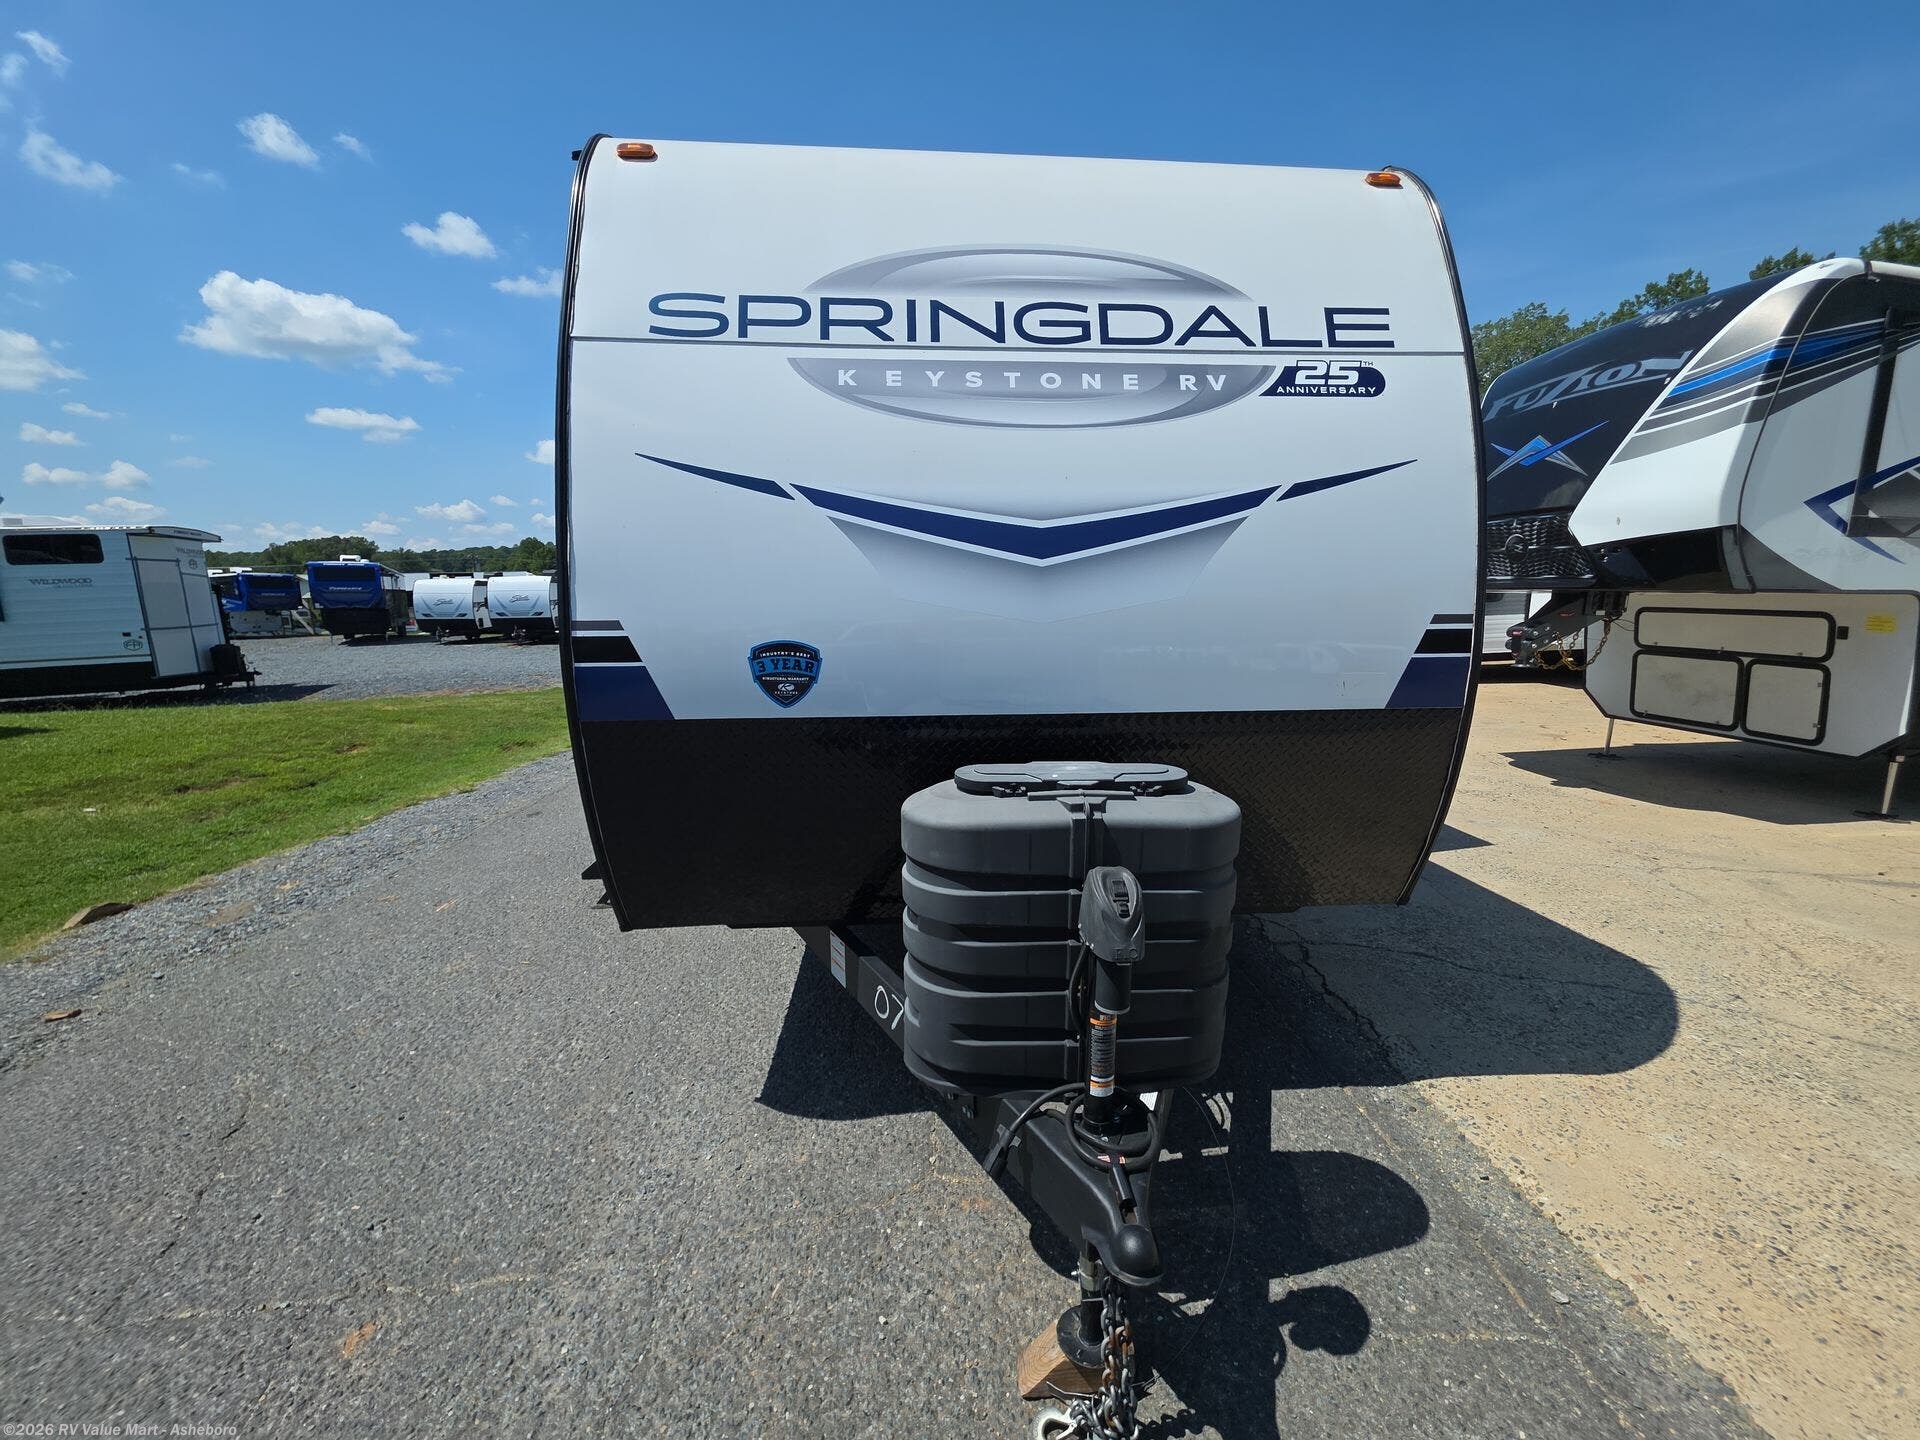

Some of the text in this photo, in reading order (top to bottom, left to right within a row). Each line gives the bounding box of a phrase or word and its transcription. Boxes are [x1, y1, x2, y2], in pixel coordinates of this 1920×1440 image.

[648, 291, 1395, 350] SPRINGDALE
[837, 368, 1227, 392] KEYSTONE RV
[1276, 386, 1377, 395] ANNIVERSARY
[757, 659, 815, 673] 3 YEAR
[874, 985, 904, 1030] 07
